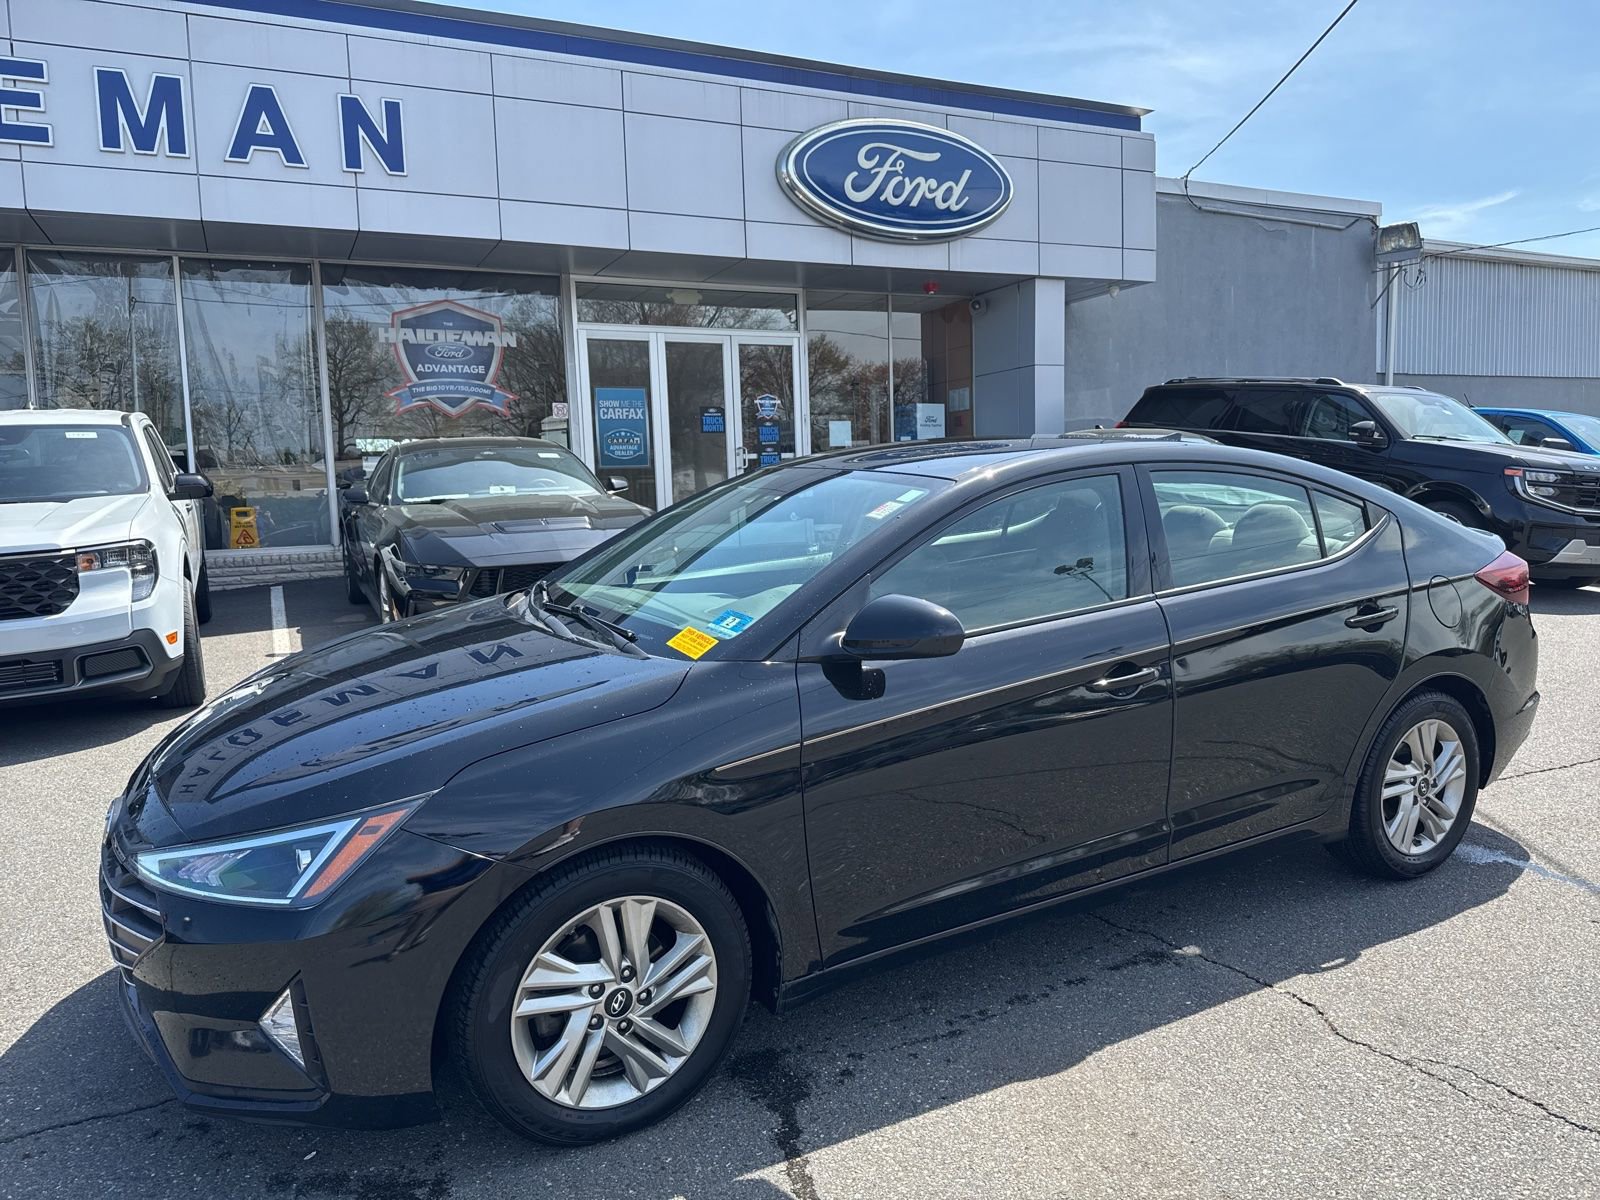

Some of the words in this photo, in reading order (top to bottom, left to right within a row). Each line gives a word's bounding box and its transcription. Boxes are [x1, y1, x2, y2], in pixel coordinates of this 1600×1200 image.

[843, 142, 973, 211] Ford
[378, 327, 517, 348] HALDEMAN
[434, 346, 465, 358] Ford
[416, 364, 486, 374] ADVANTAGE
[599, 400, 620, 408] SHOW
[620, 400, 631, 408] ME
[631, 400, 644, 408] THE
[600, 408, 644, 420] CARFAX
[702, 416, 724, 425] TRUCK
[758, 426, 779, 435] TRUCK
